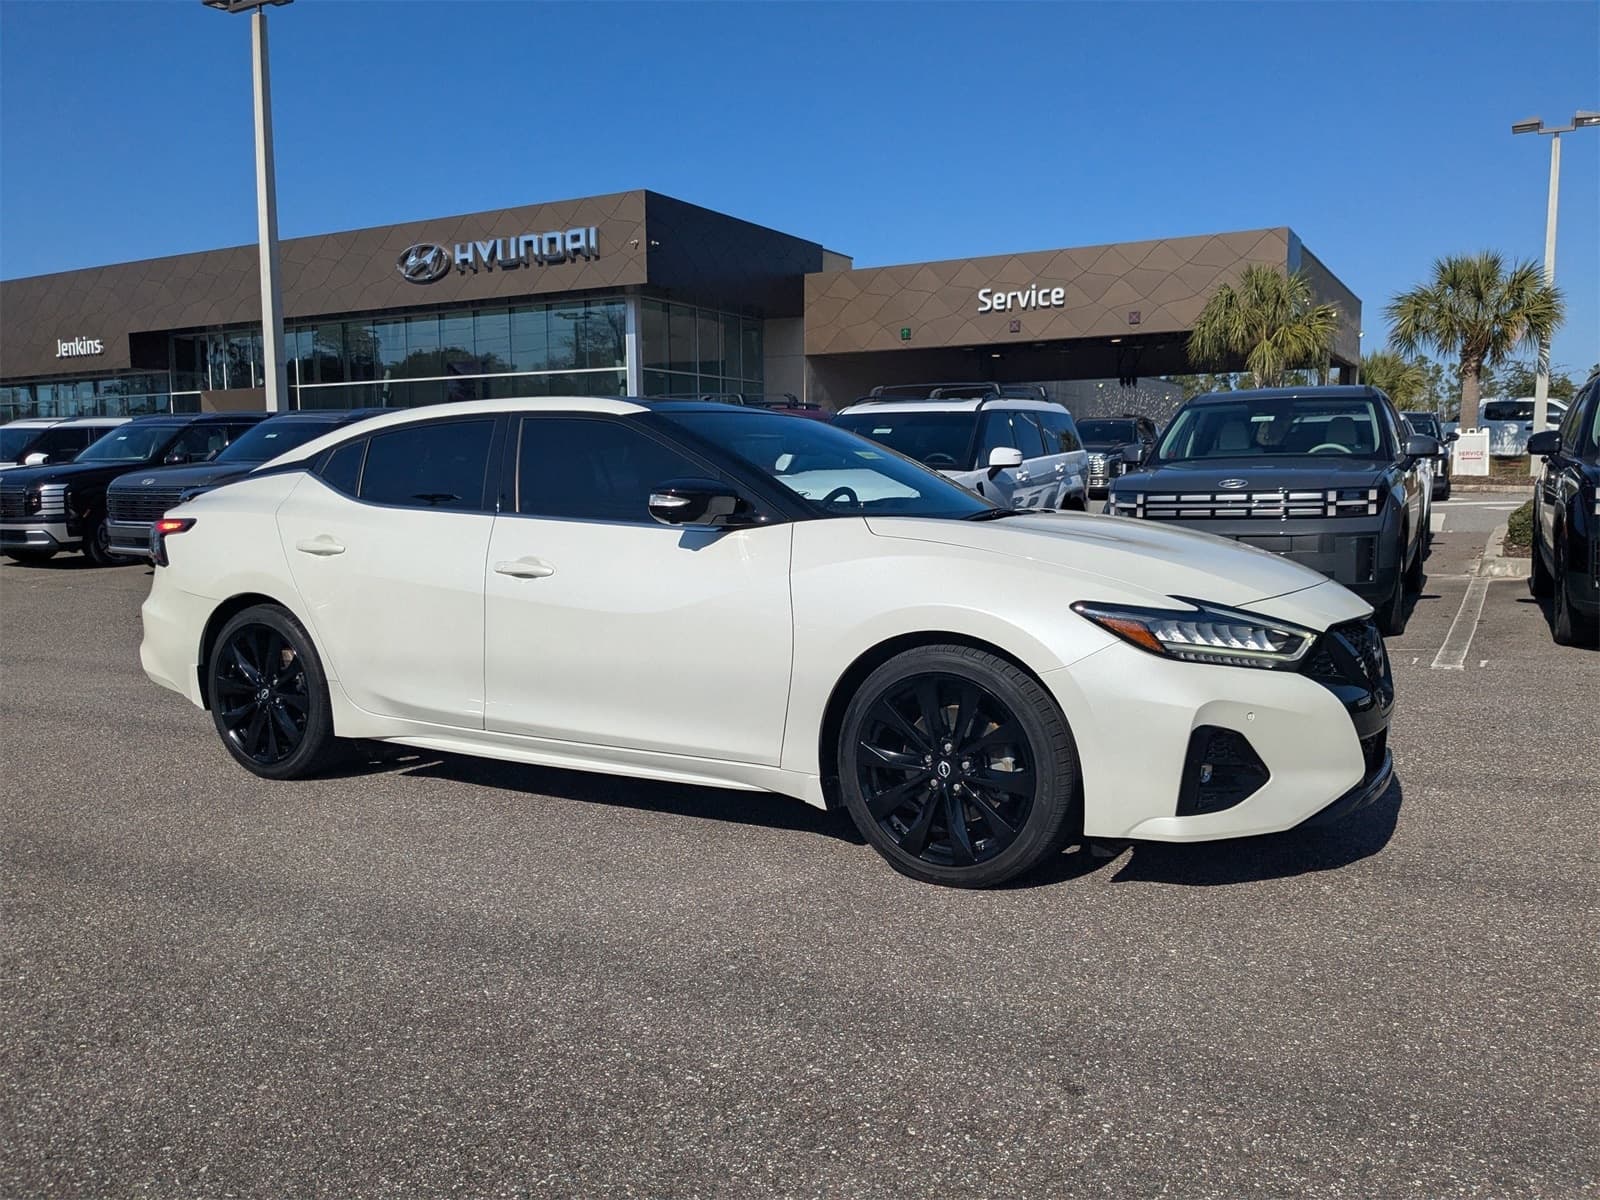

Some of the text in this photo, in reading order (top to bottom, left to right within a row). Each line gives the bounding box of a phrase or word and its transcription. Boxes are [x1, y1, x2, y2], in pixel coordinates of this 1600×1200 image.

[454, 226, 599, 271] HYUNDAI
[977, 283, 1065, 312] Service
[55, 336, 104, 358] Jenkins
